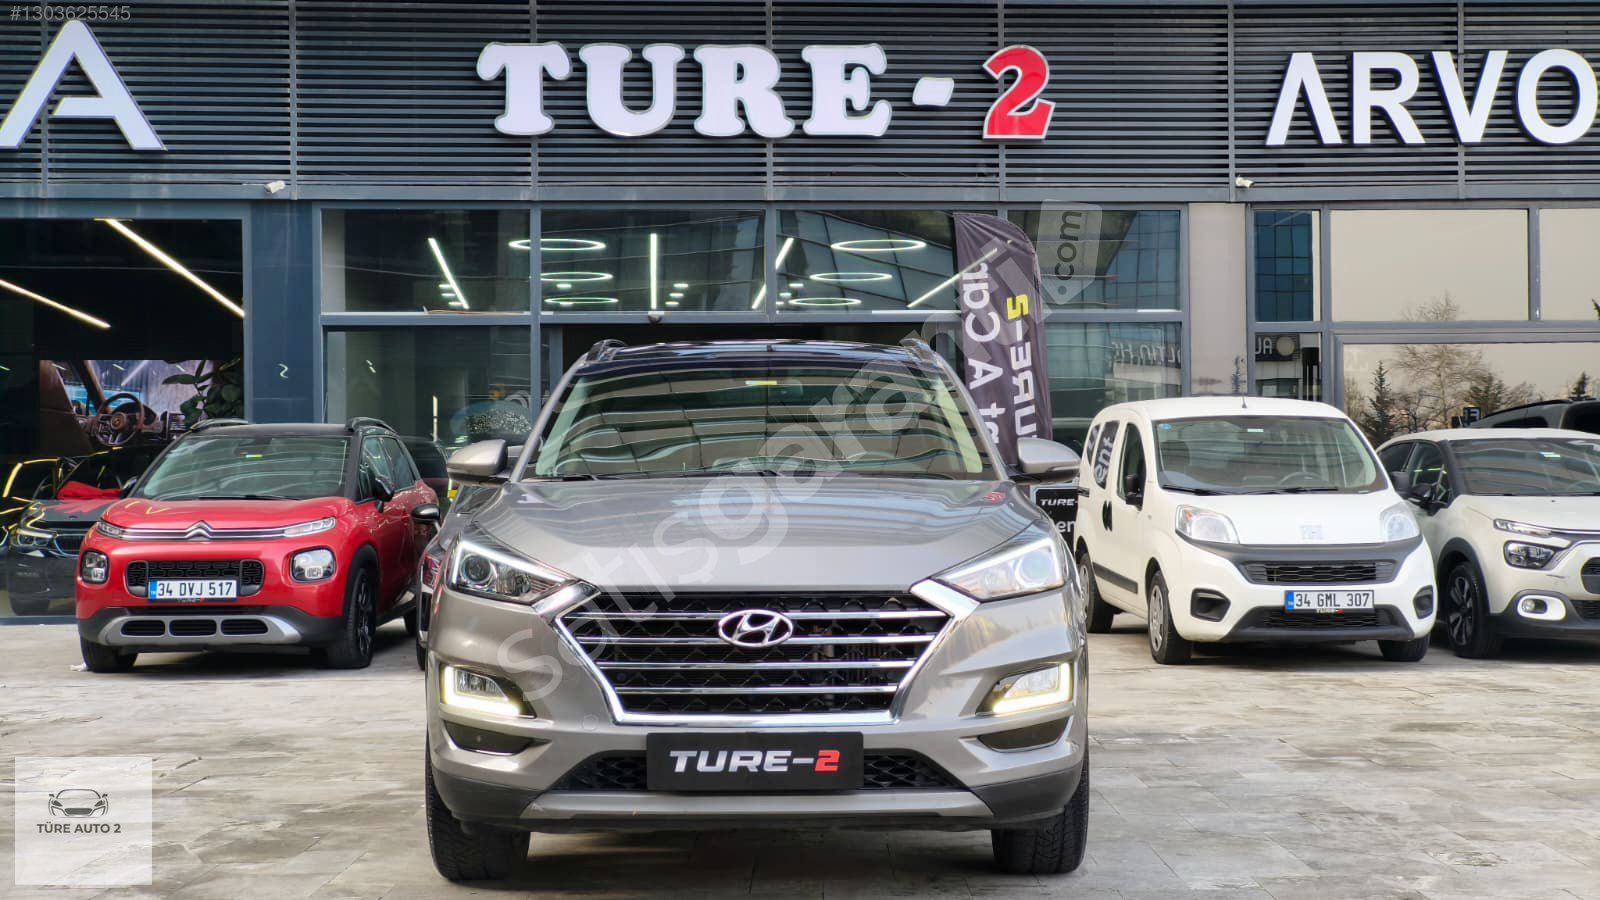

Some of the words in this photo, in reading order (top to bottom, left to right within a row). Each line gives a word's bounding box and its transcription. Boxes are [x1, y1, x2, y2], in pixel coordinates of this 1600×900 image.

[0, 20, 167, 151] A
[1041, 498, 1078, 506] TURE-
[158, 582, 173, 596] 34
[180, 582, 203, 596] DVJ
[208, 582, 233, 596] 517
[1296, 593, 1311, 607] 34
[1317, 593, 1340, 607] GML
[1346, 593, 1370, 607] 307
[669, 749, 840, 773] TURE-2
